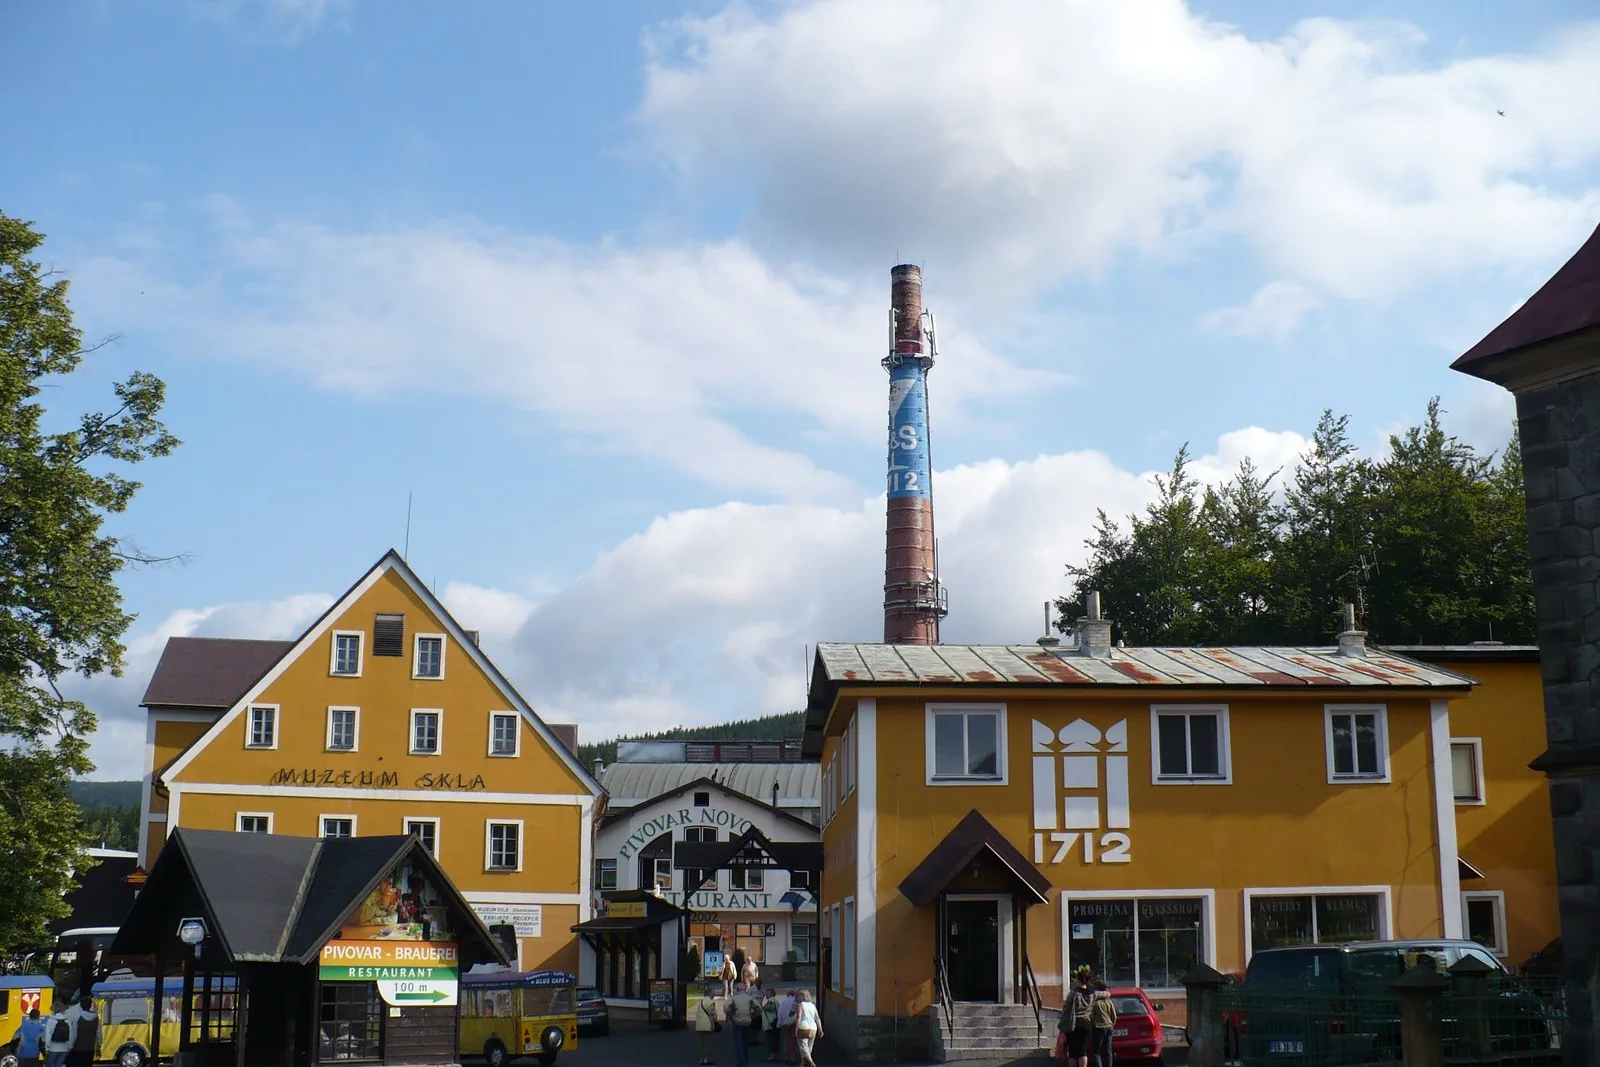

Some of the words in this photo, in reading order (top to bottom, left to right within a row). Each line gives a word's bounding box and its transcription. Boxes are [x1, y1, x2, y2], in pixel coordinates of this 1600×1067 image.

[889, 471, 919, 491] 12
[278, 768, 399, 787] MUZEUM
[422, 772, 486, 789] SKLA
[618, 808, 693, 861] PIVOVAR
[701, 808, 754, 835] NOVO
[1034, 832, 1131, 864] 1712
[664, 892, 772, 909] TAURANT
[691, 912, 719, 922] 2002
[1073, 904, 1129, 917] PRODEJNA
[766, 925, 775, 935] 4
[323, 946, 382, 959] PIVOVAR
[395, 947, 456, 960] BRAUEREI
[348, 967, 433, 978] RESTAURANT
[394, 982, 415, 992] 100
